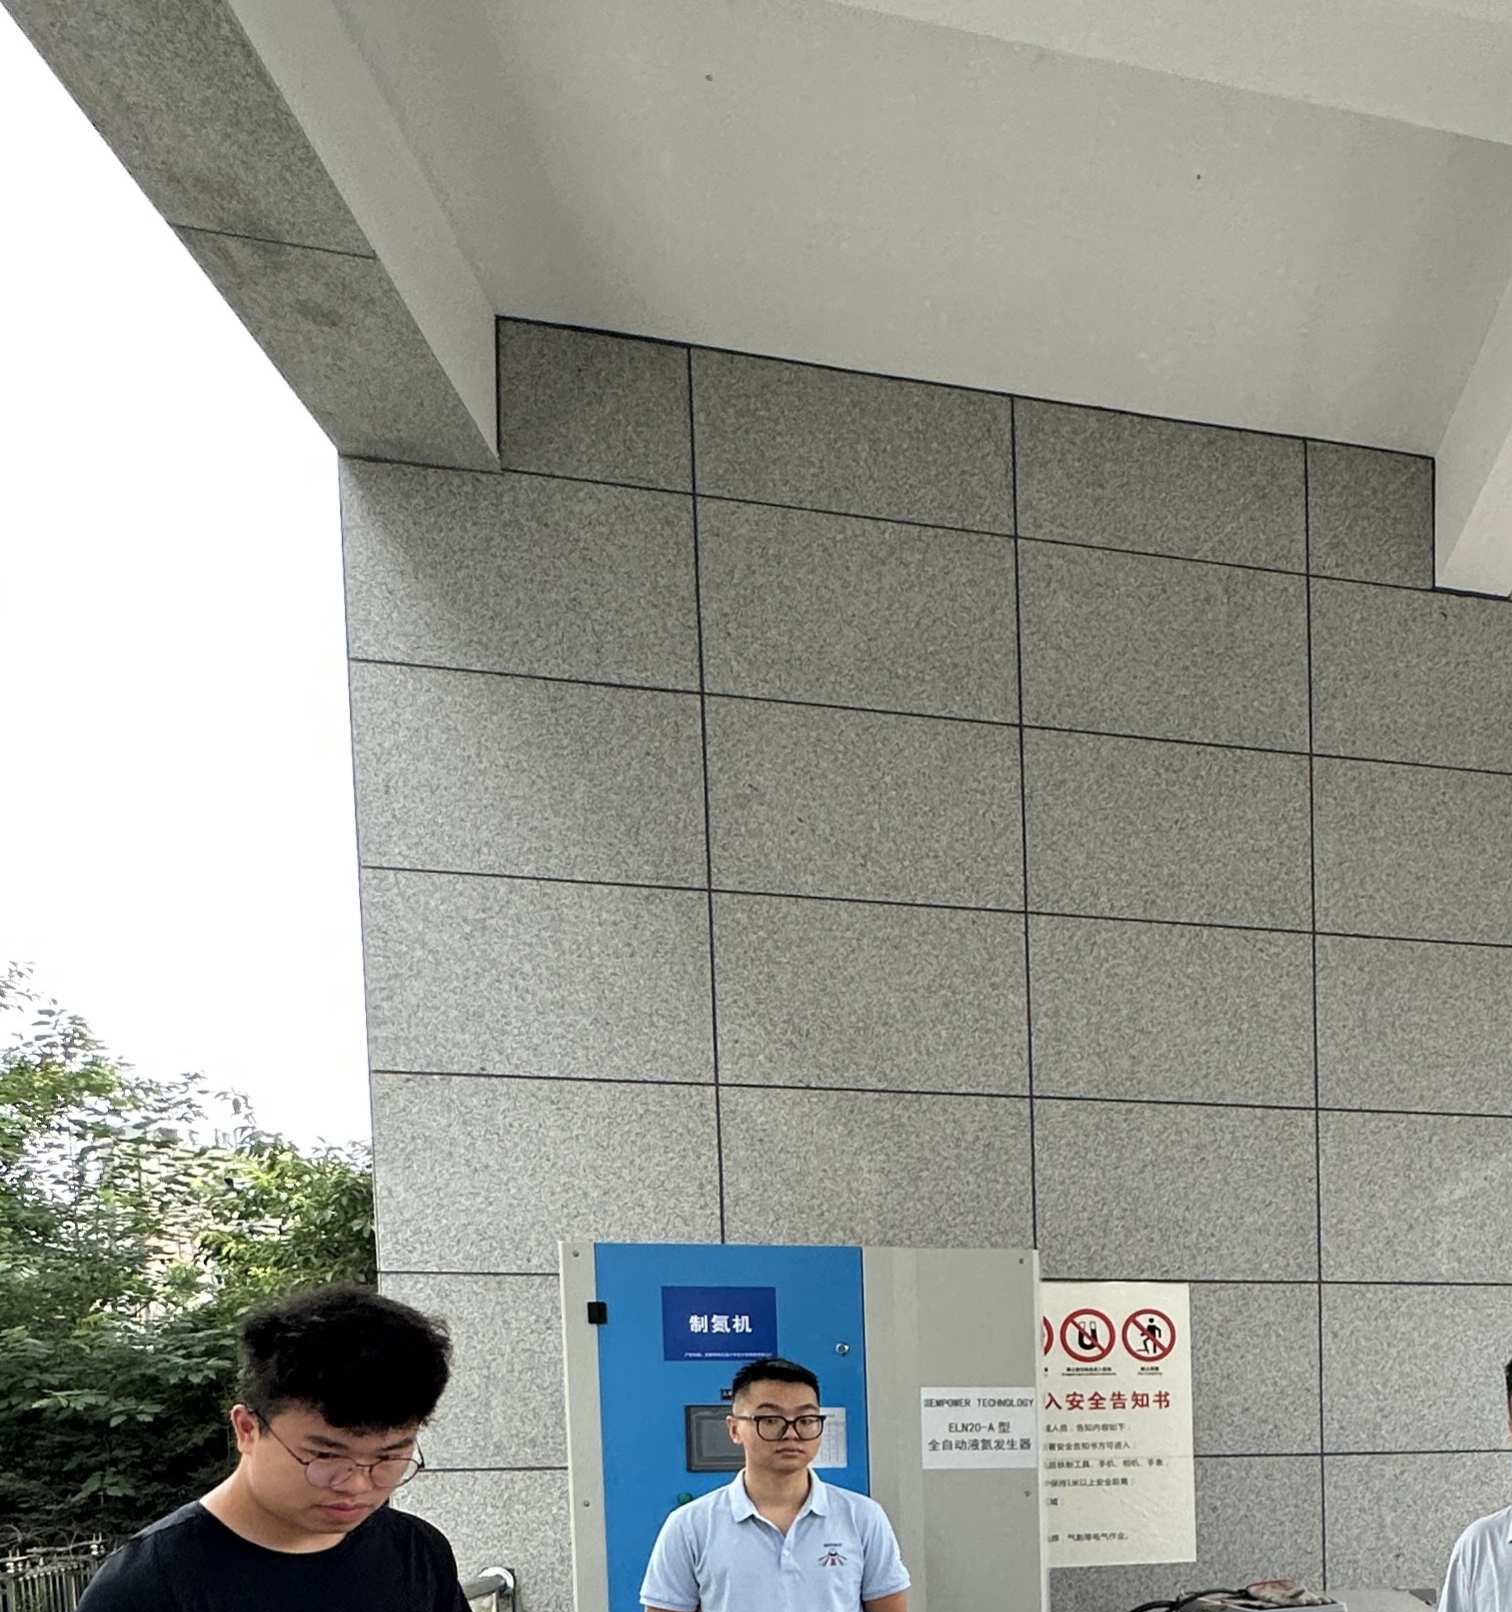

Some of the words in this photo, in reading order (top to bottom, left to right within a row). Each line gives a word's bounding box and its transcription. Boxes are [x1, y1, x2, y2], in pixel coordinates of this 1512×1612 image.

[688, 1313, 753, 1334] 制氮机
[977, 1398, 1034, 1408] TECHNOLOGY
[1044, 1390, 1171, 1411] 入安全告知书
[948, 1422, 995, 1433] ELN20-A
[927, 1438, 1032, 1452] 全自动液氮发生器
